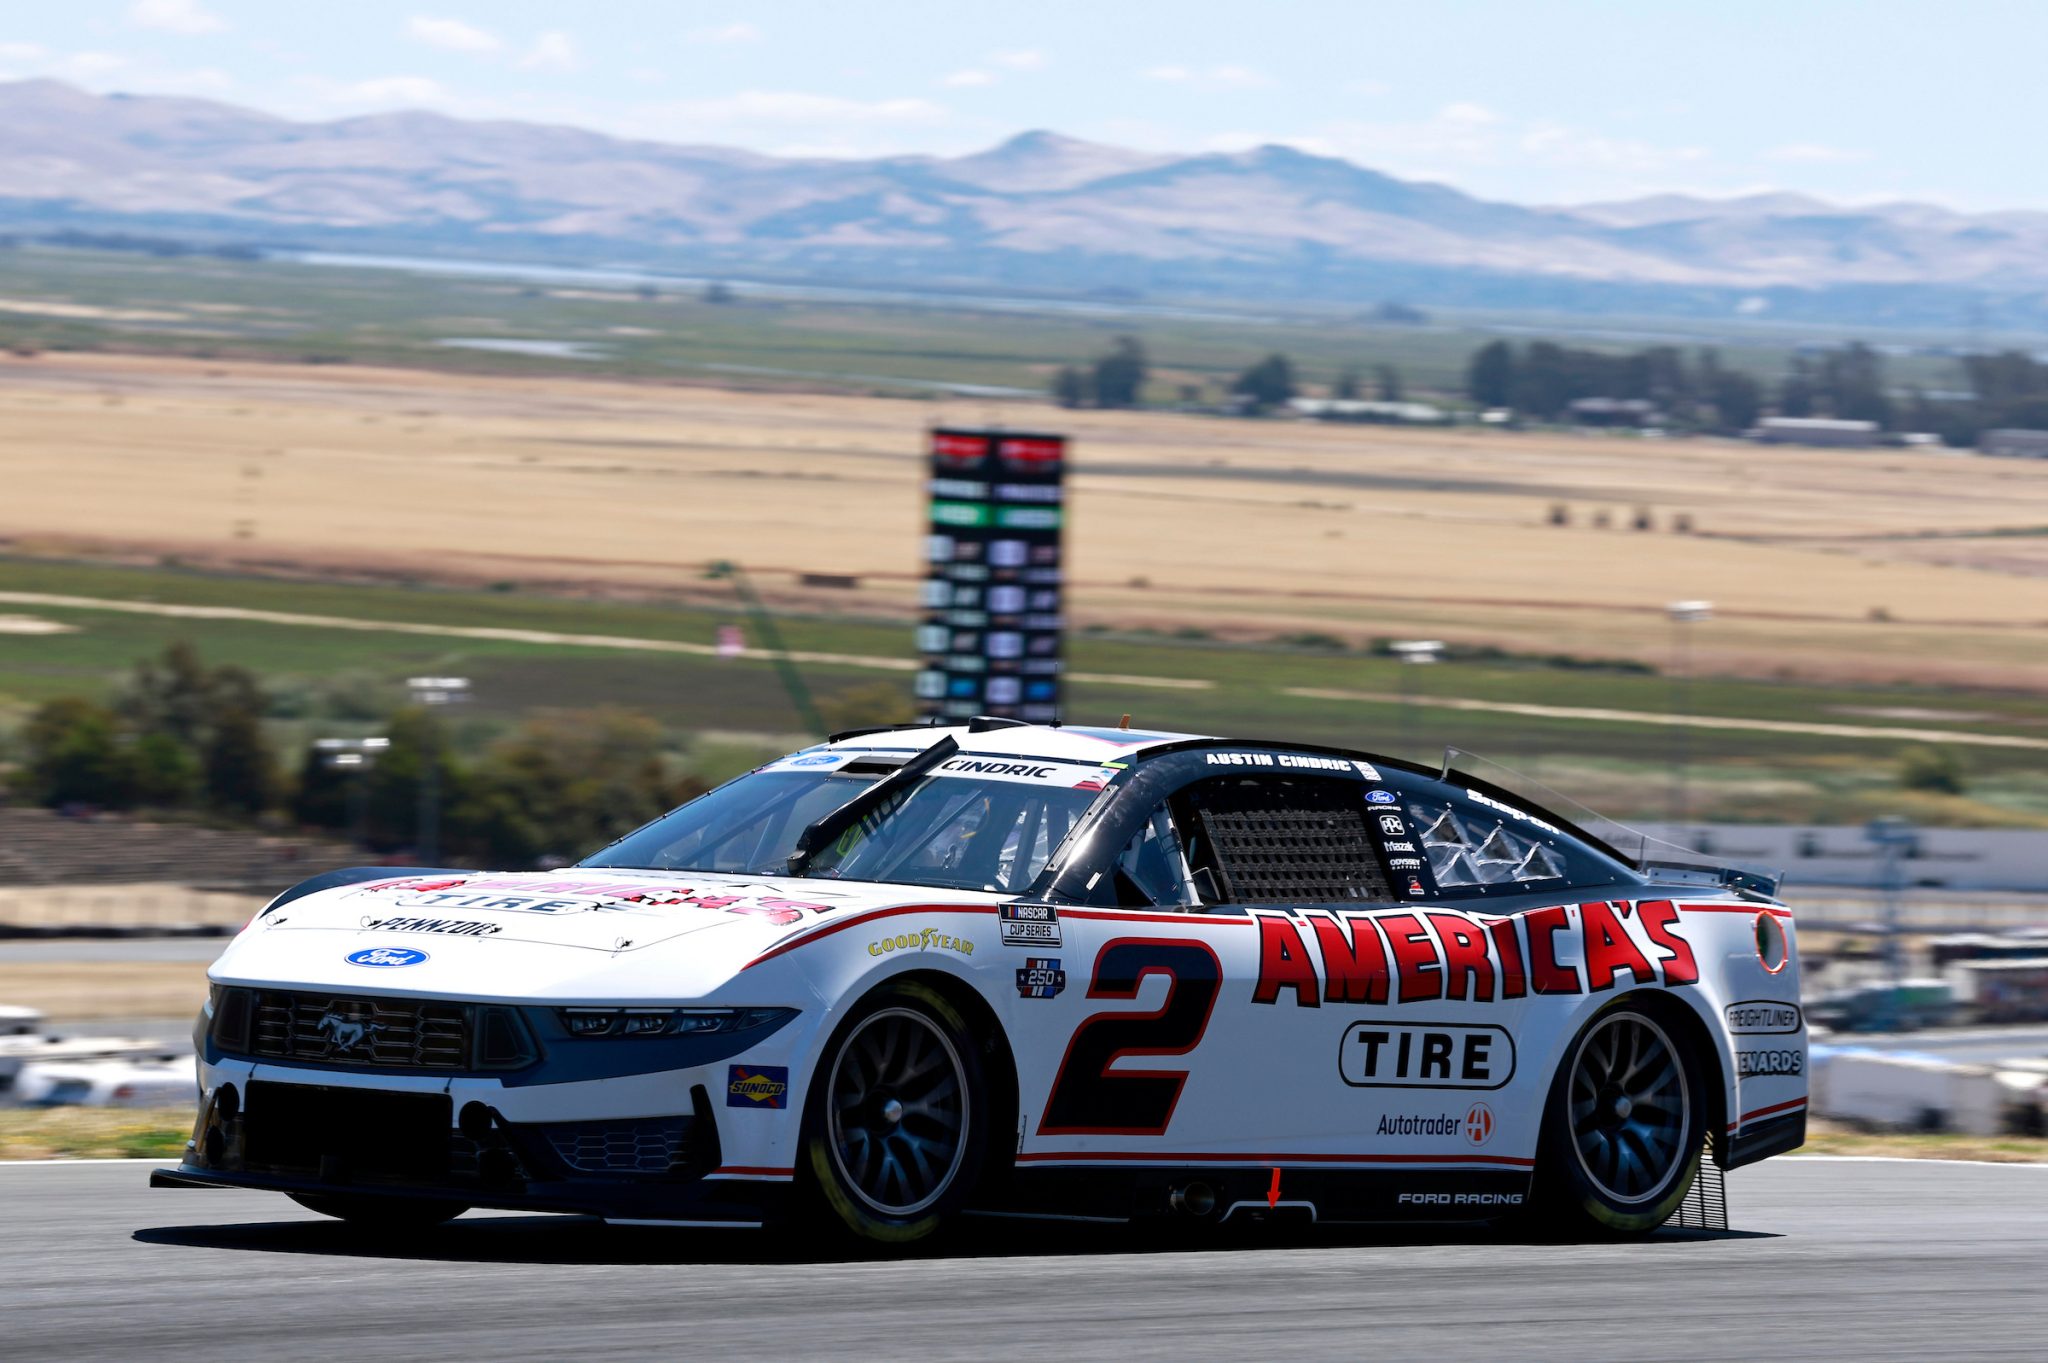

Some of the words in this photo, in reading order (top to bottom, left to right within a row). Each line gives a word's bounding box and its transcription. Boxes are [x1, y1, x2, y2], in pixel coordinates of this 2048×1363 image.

[941, 760, 1058, 779] CINDRIC
[1206, 753, 1274, 766] AUSTIN
[1278, 755, 1352, 772] CINDRIC
[1370, 791, 1392, 802] Ford
[1383, 841, 1416, 852] Mazak
[1390, 858, 1420, 866] ODYSSEY
[424, 893, 578, 913] TIRE
[1017, 905, 1048, 920] NASCAR
[1010, 924, 1025, 936] CUP
[1026, 924, 1052, 937] SERIES
[355, 948, 420, 967] Ford
[1252, 899, 1700, 1009] AMERICA'S
[1027, 970, 1055, 986] 250
[1728, 1008, 1796, 1027] FREIGHTLINER
[1037, 935, 1223, 1137] 2
[1358, 1031, 1492, 1080] TIRE
[1735, 1050, 1803, 1074] ENARDS
[731, 1082, 784, 1095] SUNOCO
[1376, 1113, 1461, 1136] Autotrader
[1398, 1193, 1450, 1204] FORD
[1454, 1193, 1524, 1205] RACING
